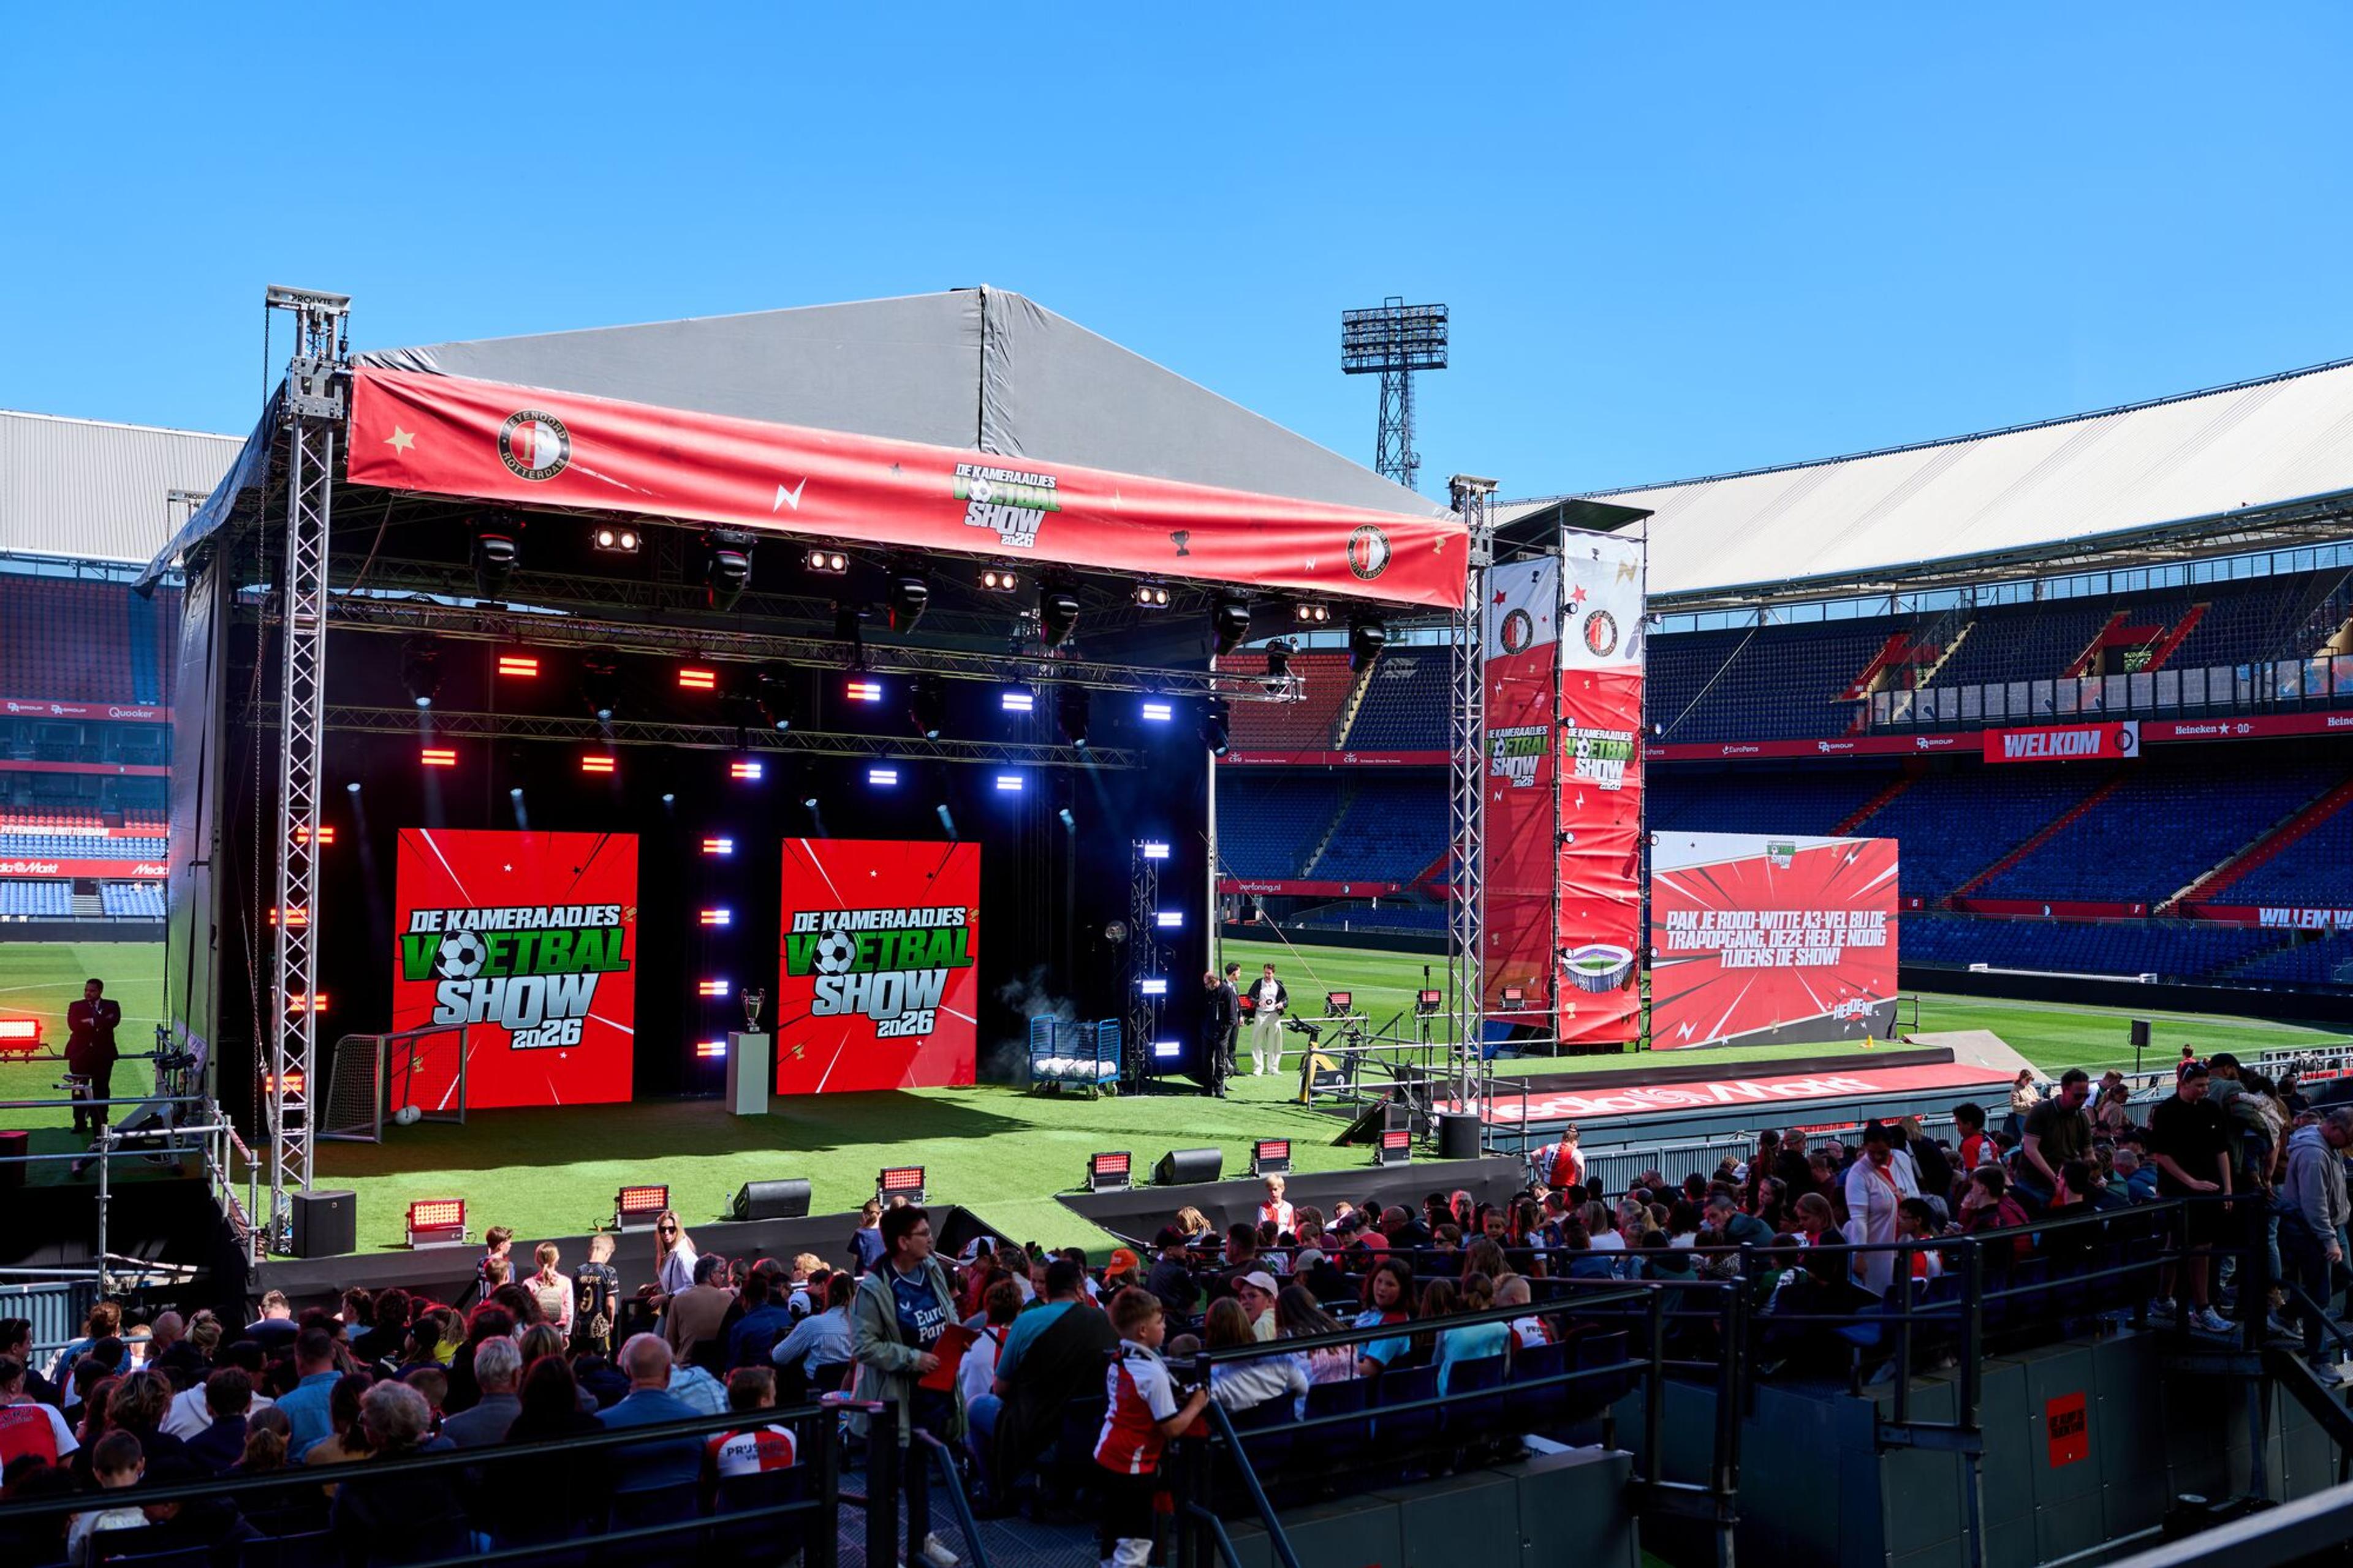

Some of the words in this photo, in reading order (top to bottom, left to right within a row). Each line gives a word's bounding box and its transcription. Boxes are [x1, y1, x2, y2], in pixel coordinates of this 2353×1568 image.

[504, 411, 566, 439] FEYENOORD
[502, 452, 567, 479] ROTTERDAM
[955, 463, 972, 477] DE
[972, 466, 1056, 488] KAMERAADJES
[964, 501, 1046, 536] SHOW
[1001, 532, 1035, 548] 2026
[108, 706, 154, 719] Quooker
[2175, 724, 2217, 735] Heineken
[2004, 730, 2101, 757] WELKOM
[1490, 756, 1540, 779] SHOW
[1574, 758, 1626, 782] SHOW
[409, 910, 442, 933] DE
[446, 905, 621, 931] KAMERAADJES
[792, 912, 820, 933] DE
[821, 907, 966, 931] KAMERAADJES
[1666, 911, 1699, 930] PAK
[1699, 911, 1716, 930] JE
[1716, 911, 1802, 930] ROOD-WITTE
[1802, 911, 1847, 930] A3-VEL
[1849, 911, 1869, 929] BIJ
[1870, 911, 1887, 928] DE
[2259, 907, 2331, 929] WILLEM
[1769, 930, 1803, 948] DEZE
[1804, 930, 1830, 947] HEB
[1831, 930, 1846, 947] JE
[1847, 930, 1887, 947] NOODIG
[1721, 949, 1775, 968] TIJDENS
[1775, 949, 1795, 967] DE
[1795, 949, 1841, 966] SHOW!
[433, 973, 601, 1029] SHOW
[812, 969, 949, 1020] SHOW
[1833, 998, 1873, 1020] HELDEN!
[512, 1018, 582, 1049] 2026
[877, 1010, 934, 1037] 2026
[579, 1286, 594, 1314] 9
